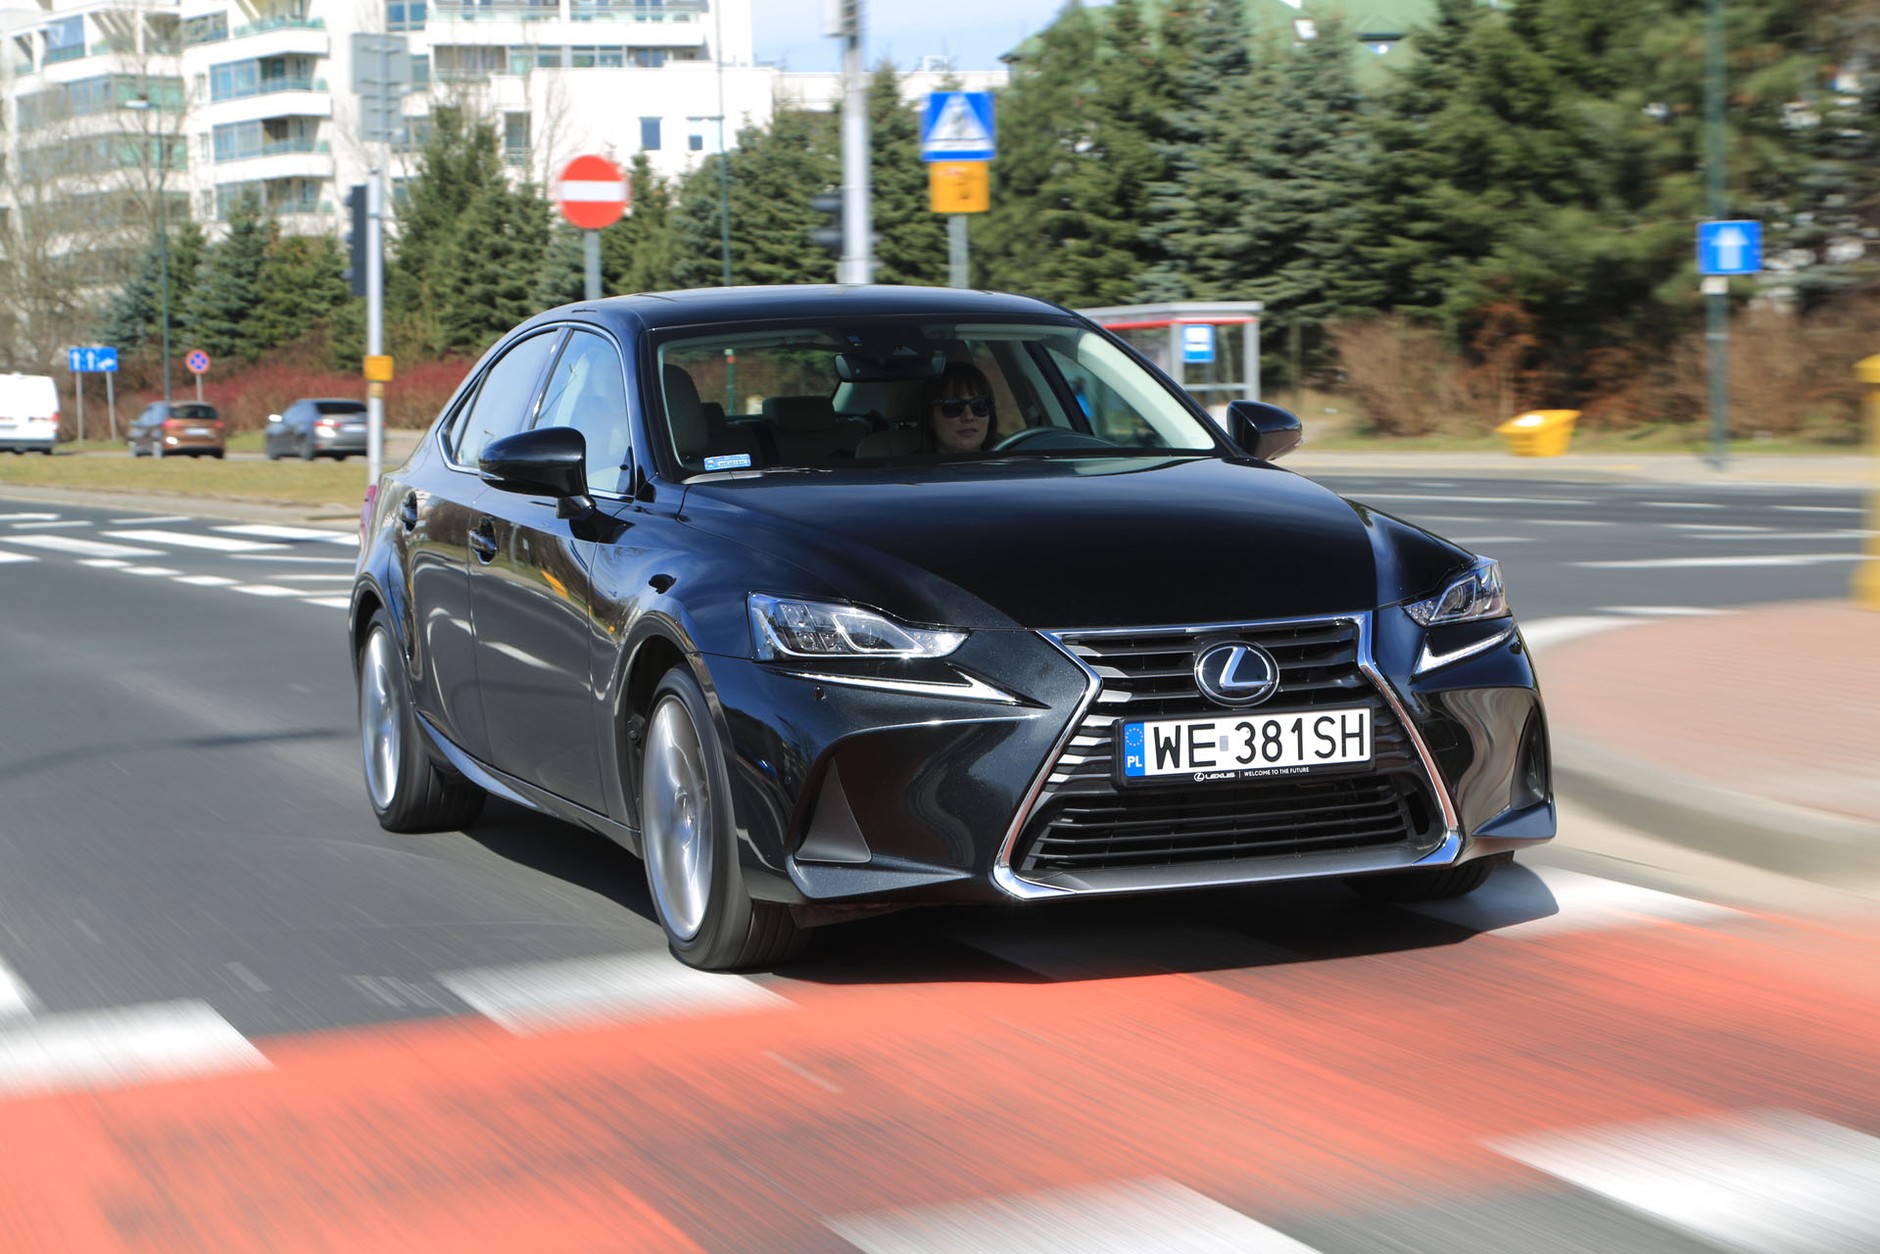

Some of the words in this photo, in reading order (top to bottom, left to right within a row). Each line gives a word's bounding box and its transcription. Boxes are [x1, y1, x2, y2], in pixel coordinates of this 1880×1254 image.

[1153, 723, 1217, 770] WE
[1234, 713, 1364, 765] 381SH
[1127, 756, 1143, 768] PL
[1205, 772, 1236, 780] LEXUS
